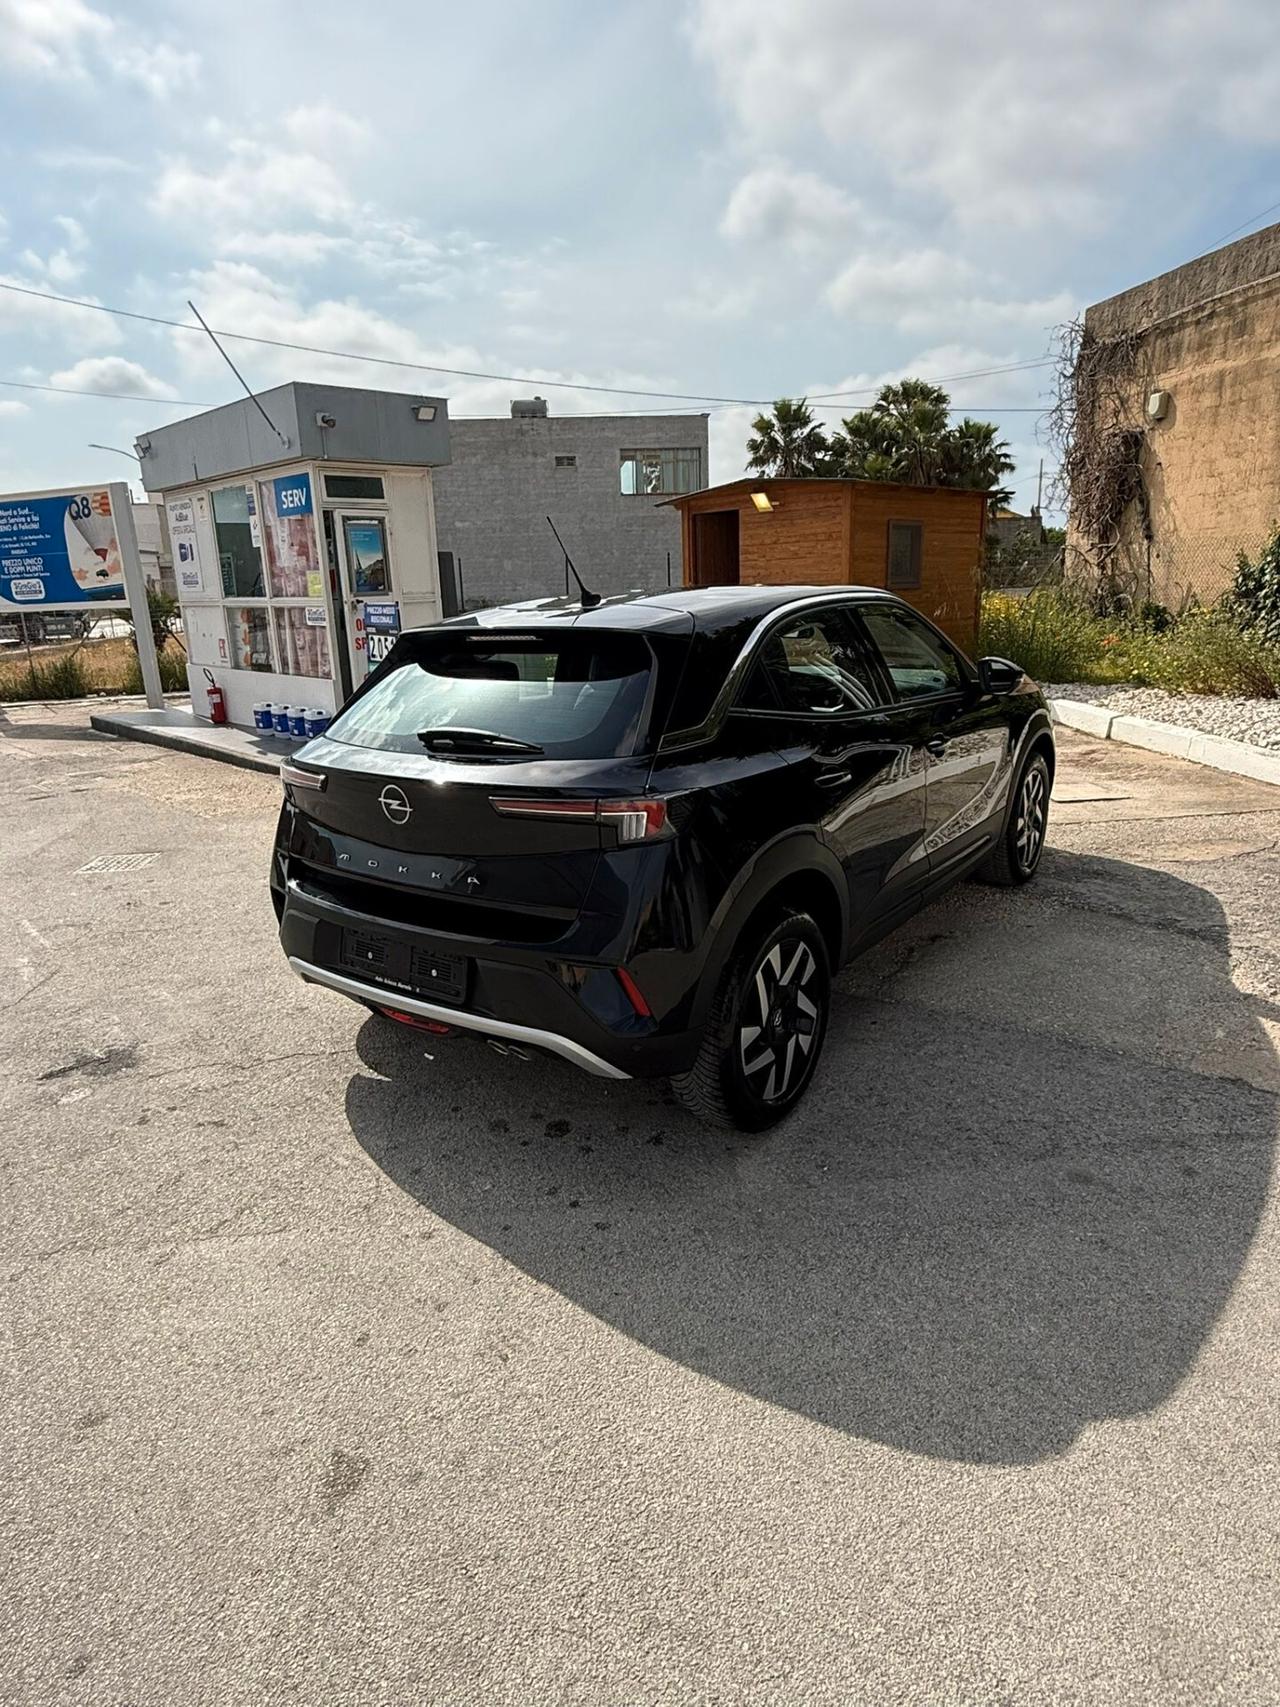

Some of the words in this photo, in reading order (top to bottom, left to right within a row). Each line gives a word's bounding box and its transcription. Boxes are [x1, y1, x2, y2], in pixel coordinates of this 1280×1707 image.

[69, 496, 91, 520] Q8
[281, 487, 307, 509] SERV
[2, 558, 22, 566] PREZZO
[23, 557, 43, 565] UNICO
[26, 564, 43, 572] PUNTI
[339, 853, 480, 885] MOKKA
